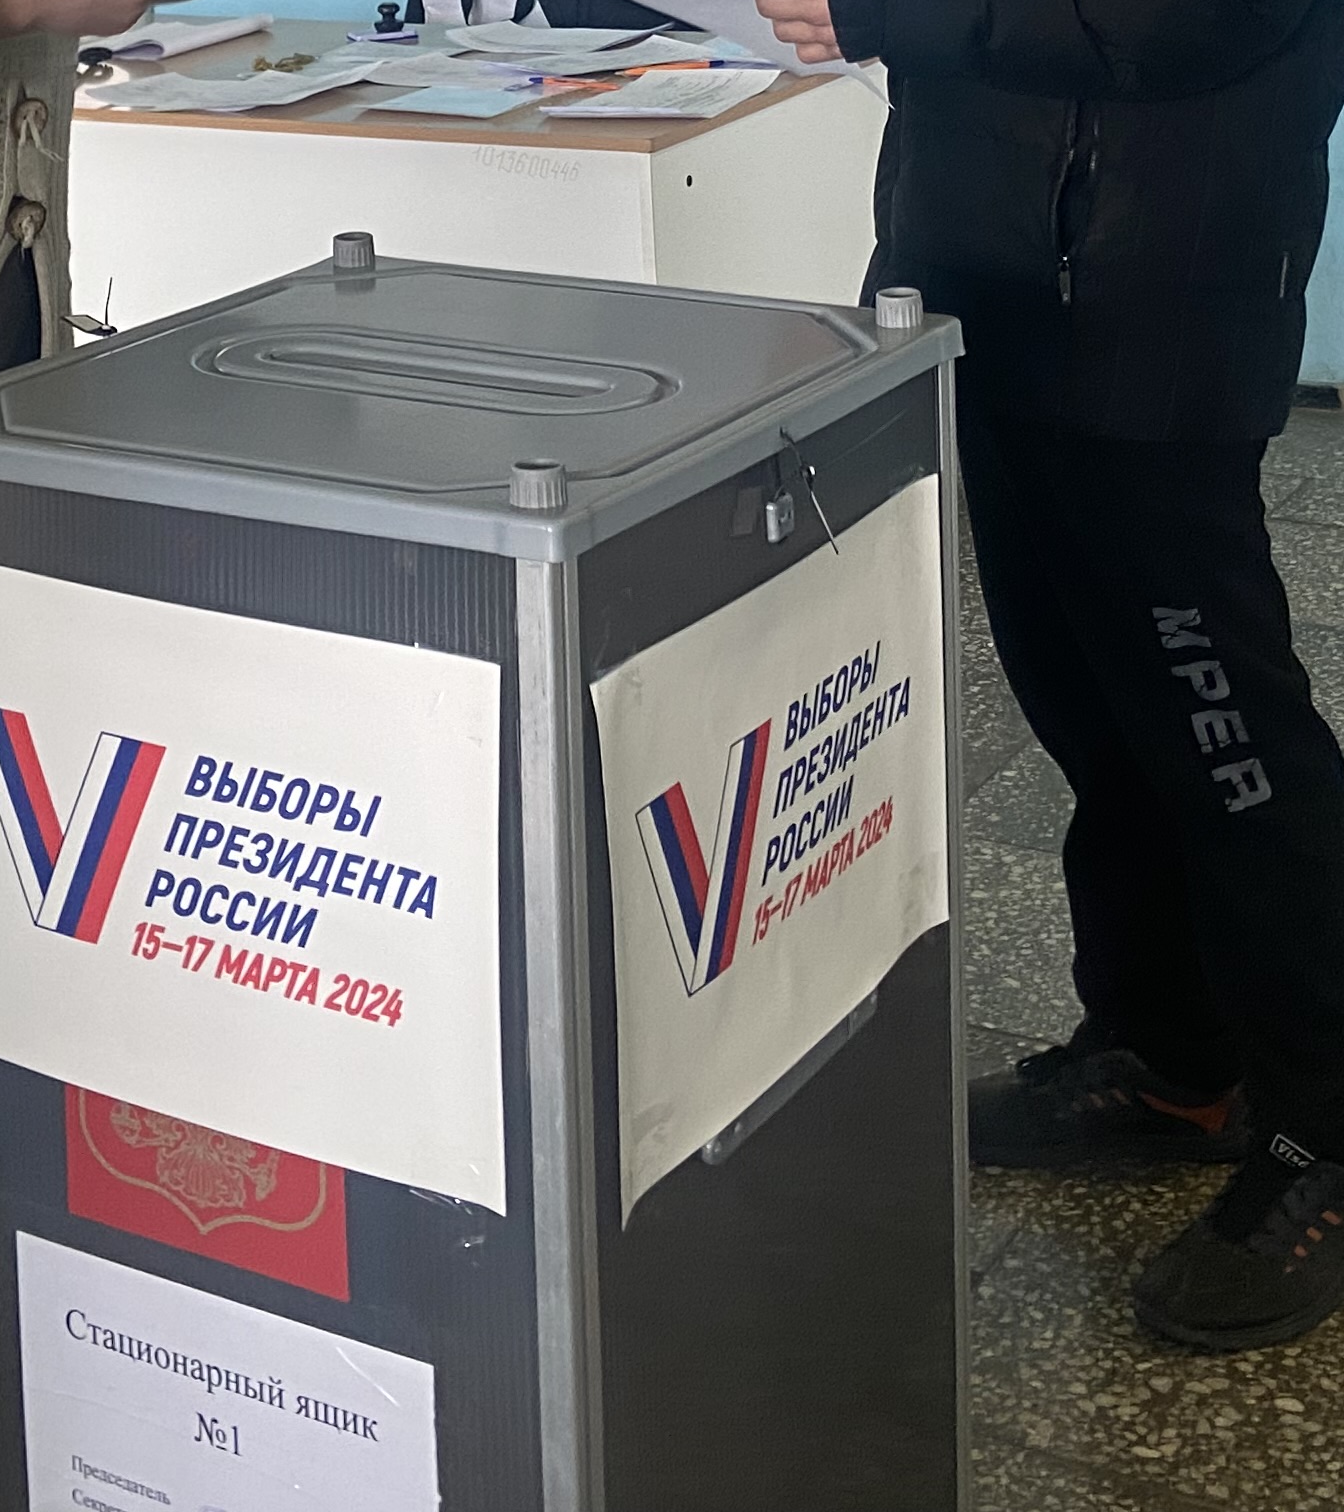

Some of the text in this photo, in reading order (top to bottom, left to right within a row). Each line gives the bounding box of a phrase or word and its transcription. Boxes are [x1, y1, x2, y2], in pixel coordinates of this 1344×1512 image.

[773, 677, 911, 819] ПРЕЗИДЕНТА
[784, 640, 881, 752] ВЫБОРЫ
[184, 755, 381, 837] ВЫБОРЫ
[761, 775, 854, 887] РОССИИ
[163, 813, 439, 919] ПРЕЗИДЕНТА
[800, 829, 856, 907] МАРТА
[856, 796, 893, 858] 2024
[144, 869, 319, 949] РОССИИ
[215, 945, 319, 1005] МАРТА
[325, 974, 404, 1027] 2024
[65, 1308, 381, 1442] Стационарный ящик
[72, 1455, 171, 1505] Председатель
